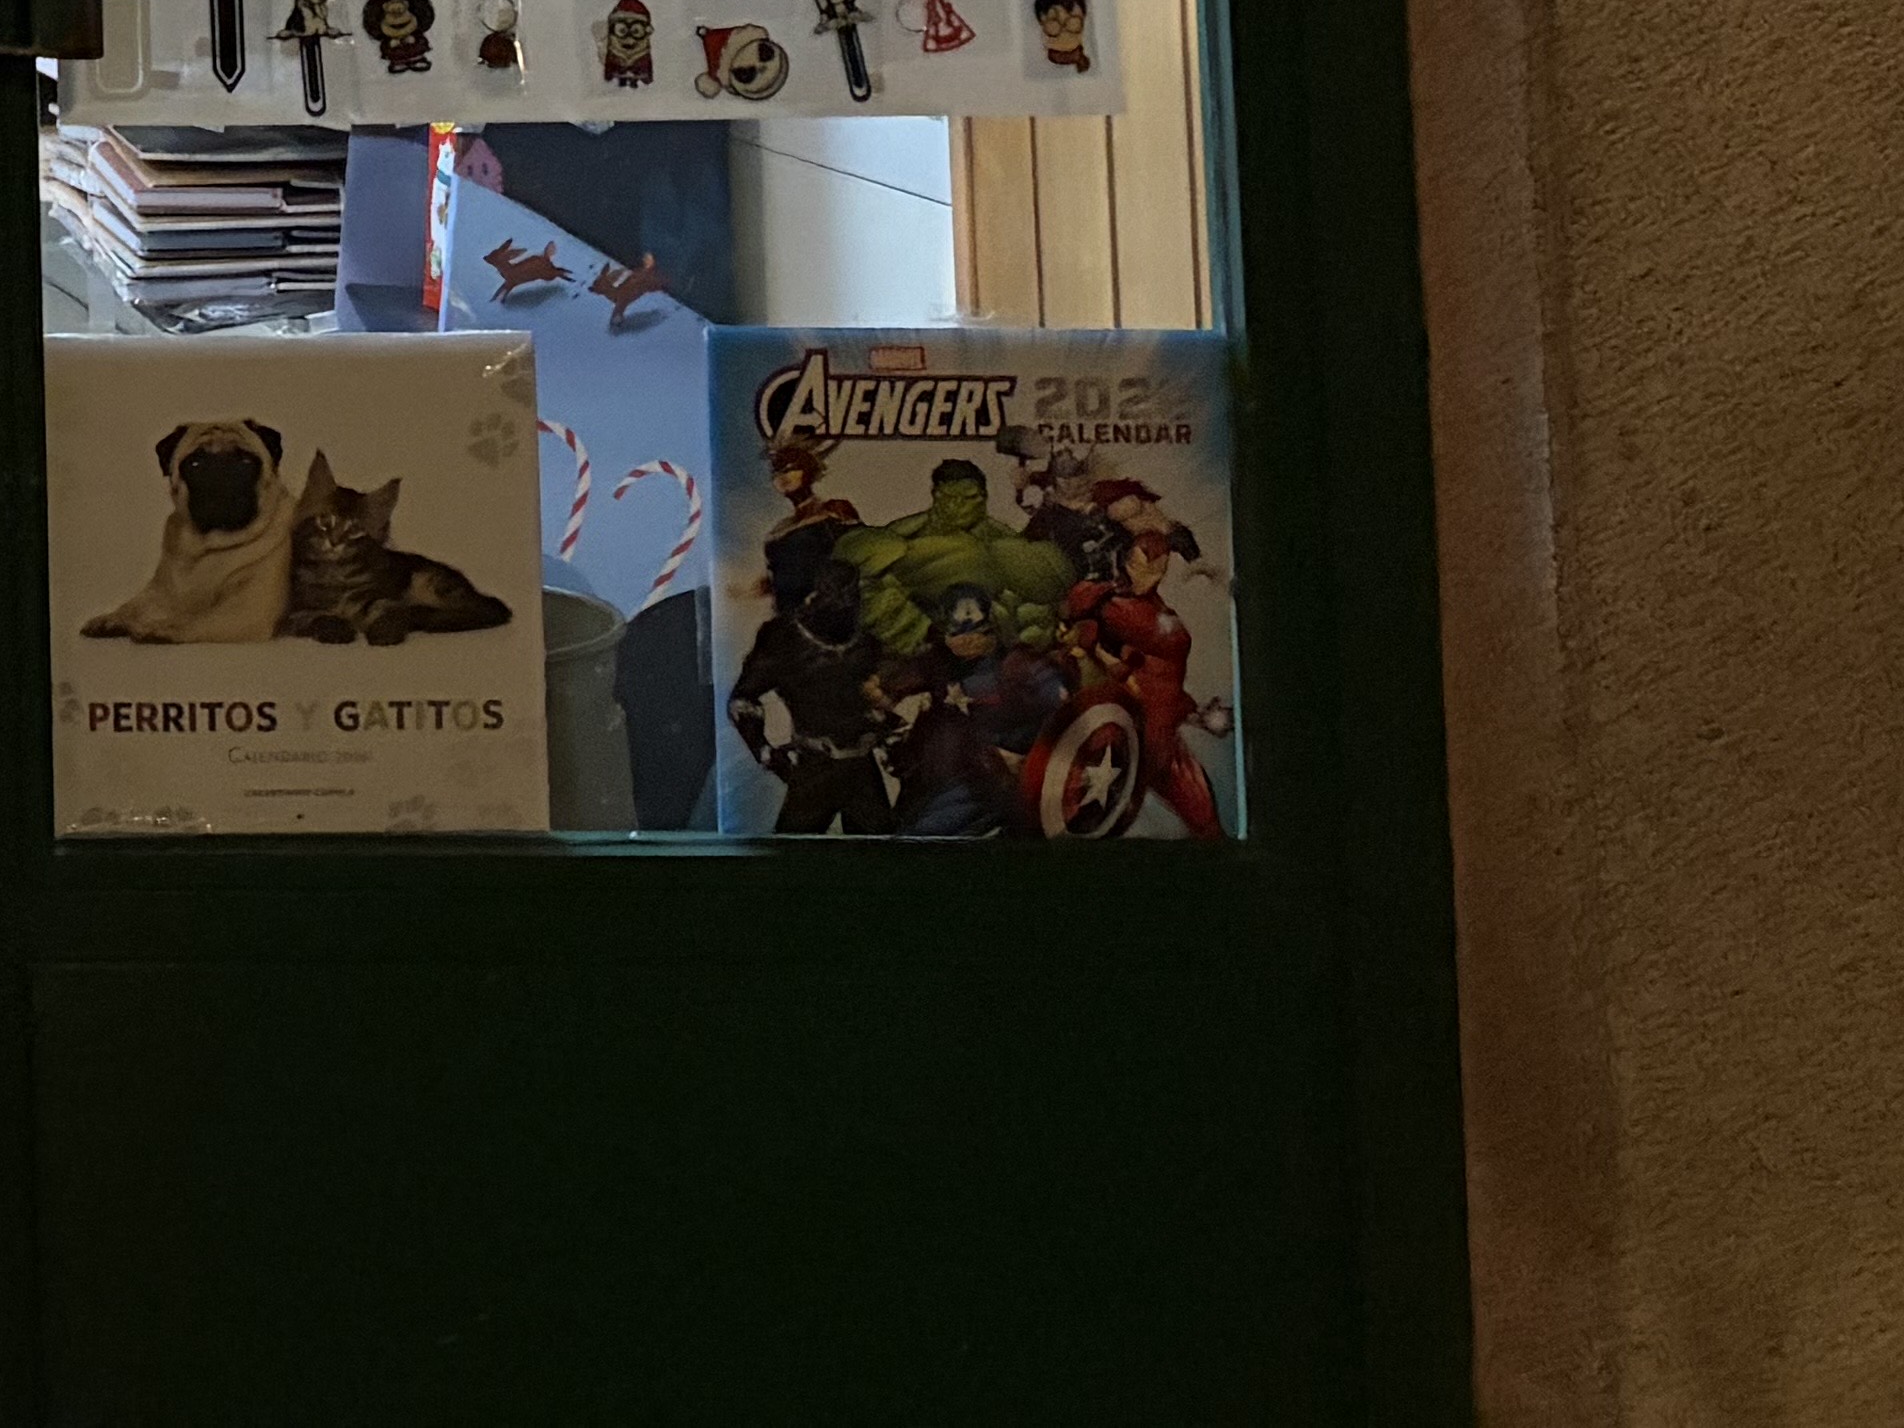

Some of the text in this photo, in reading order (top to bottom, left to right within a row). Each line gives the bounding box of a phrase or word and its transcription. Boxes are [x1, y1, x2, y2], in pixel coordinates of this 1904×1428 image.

[759, 349, 1017, 439] AVENGERS
[1038, 423, 1192, 445] CALENDAR
[89, 701, 277, 733] PERRITOS
[334, 700, 504, 731] GATITOS
